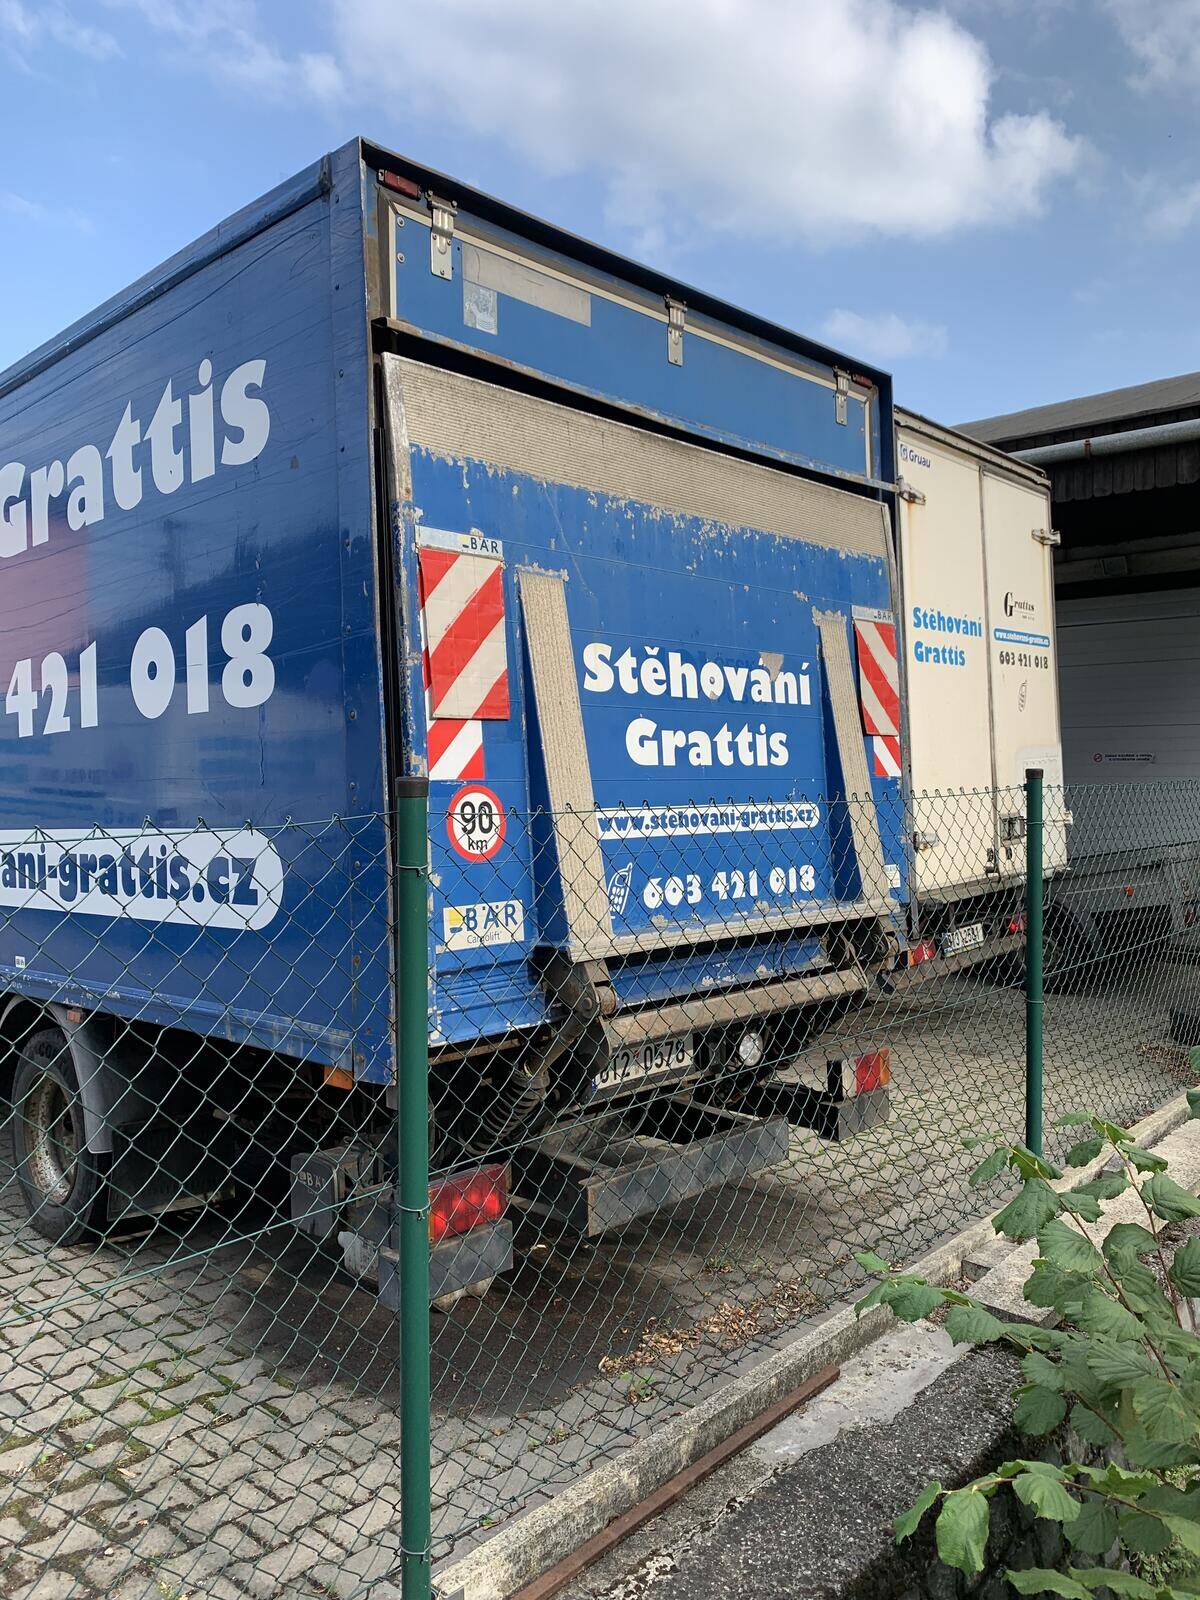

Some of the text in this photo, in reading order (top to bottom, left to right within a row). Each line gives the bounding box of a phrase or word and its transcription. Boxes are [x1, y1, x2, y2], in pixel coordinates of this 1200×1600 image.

[0, 359, 270, 558] Grattis
[909, 450, 931, 468] Gruau
[912, 606, 982, 637] Stěhování
[914, 640, 966, 666] Grattis
[999, 651, 1049, 669] 603 421 018
[5, 602, 276, 738] 421 018
[582, 642, 812, 706] Stěhování
[625, 722, 790, 767] Grattis
[460, 801, 493, 835] 90
[596, 808, 814, 833] www.stehovani-grattis.cz
[467, 837, 488, 851] km
[643, 864, 816, 909] 603 421 018
[465, 903, 519, 932] BÄR
[643, 1040, 686, 1073] 0578
